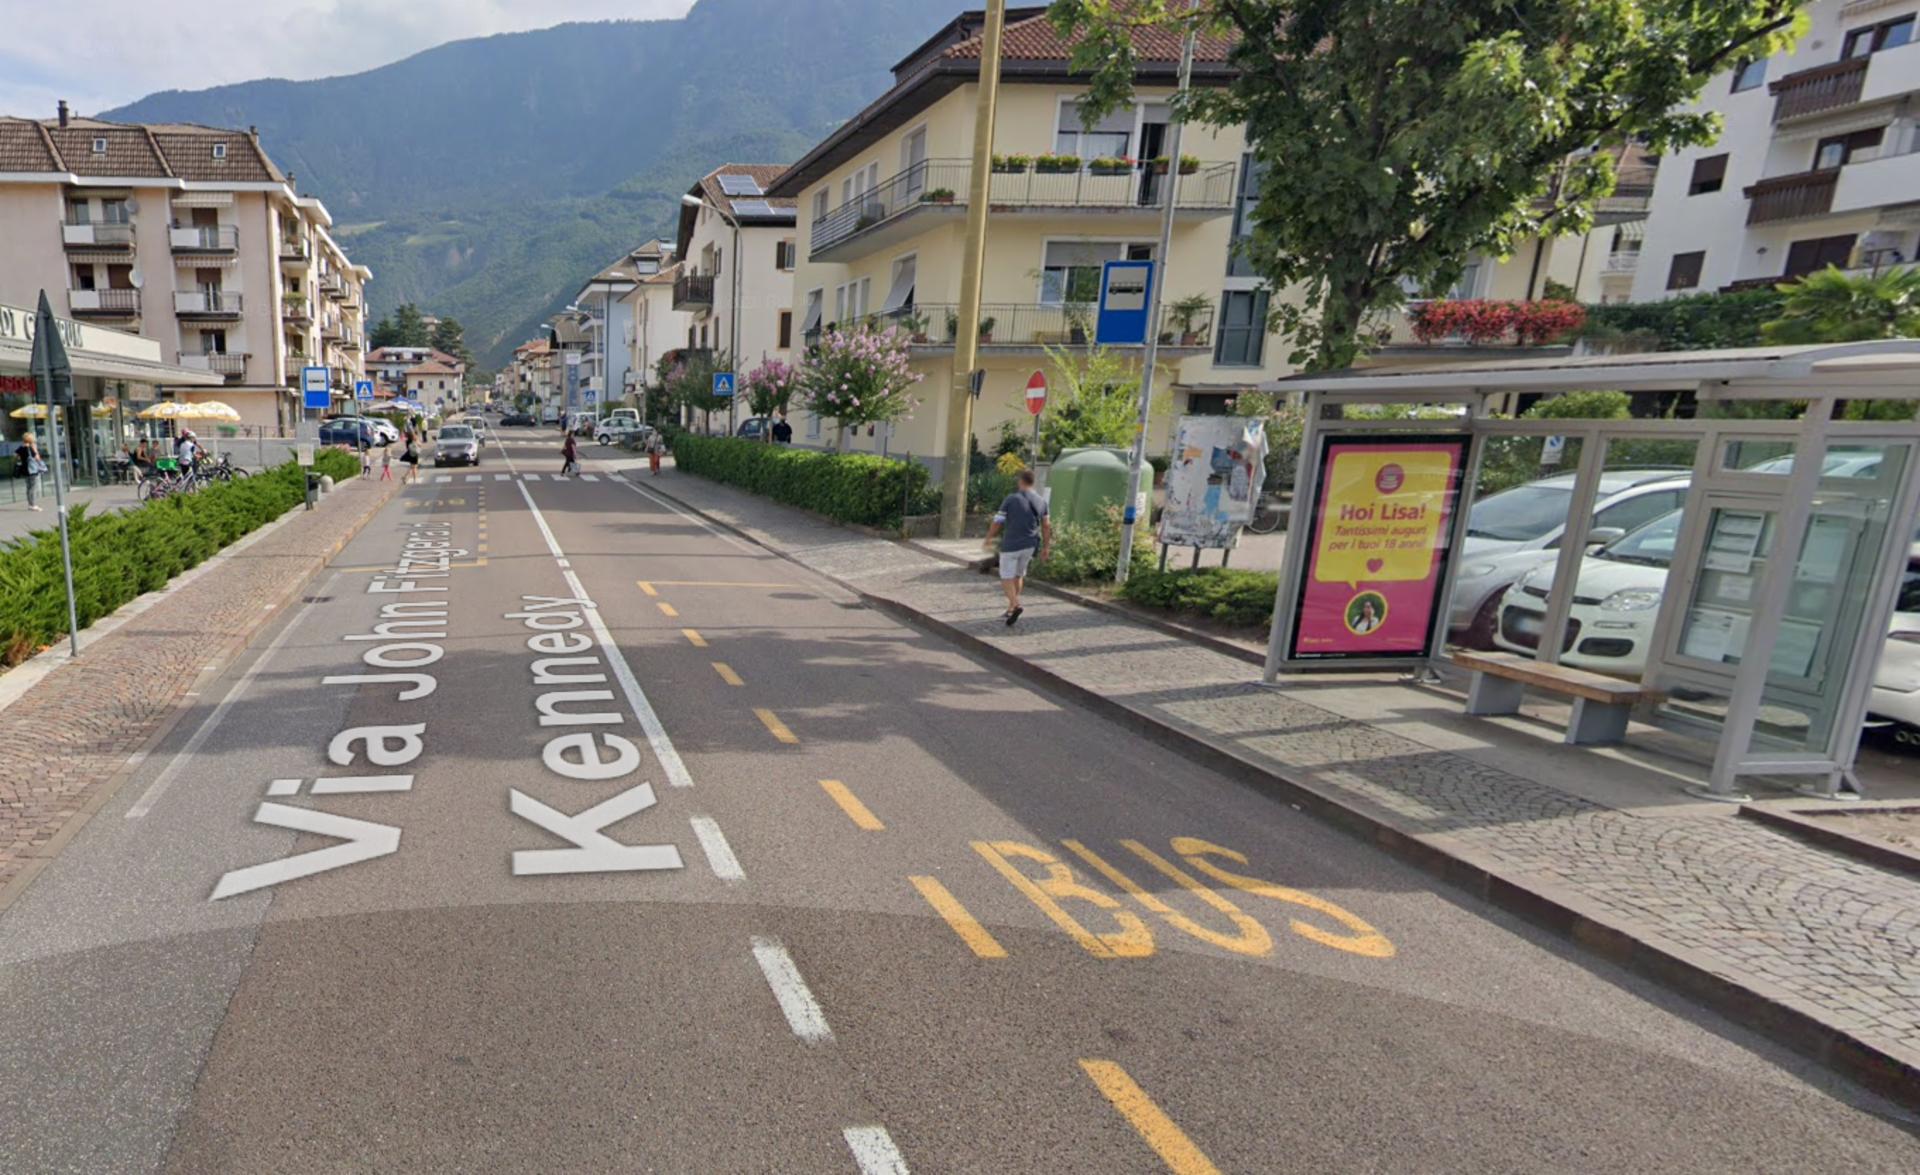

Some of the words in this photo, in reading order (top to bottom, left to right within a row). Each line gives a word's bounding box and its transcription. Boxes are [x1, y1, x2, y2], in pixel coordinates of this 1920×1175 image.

[1340, 503, 1374, 521] Hoi
[1380, 502, 1426, 520] Lisa!
[1390, 525, 1428, 538] auguri
[1328, 541, 1348, 552] per
[1358, 540, 1380, 550] tuoi
[1384, 538, 1396, 549] 18
[967, 836, 1396, 959] BUS
